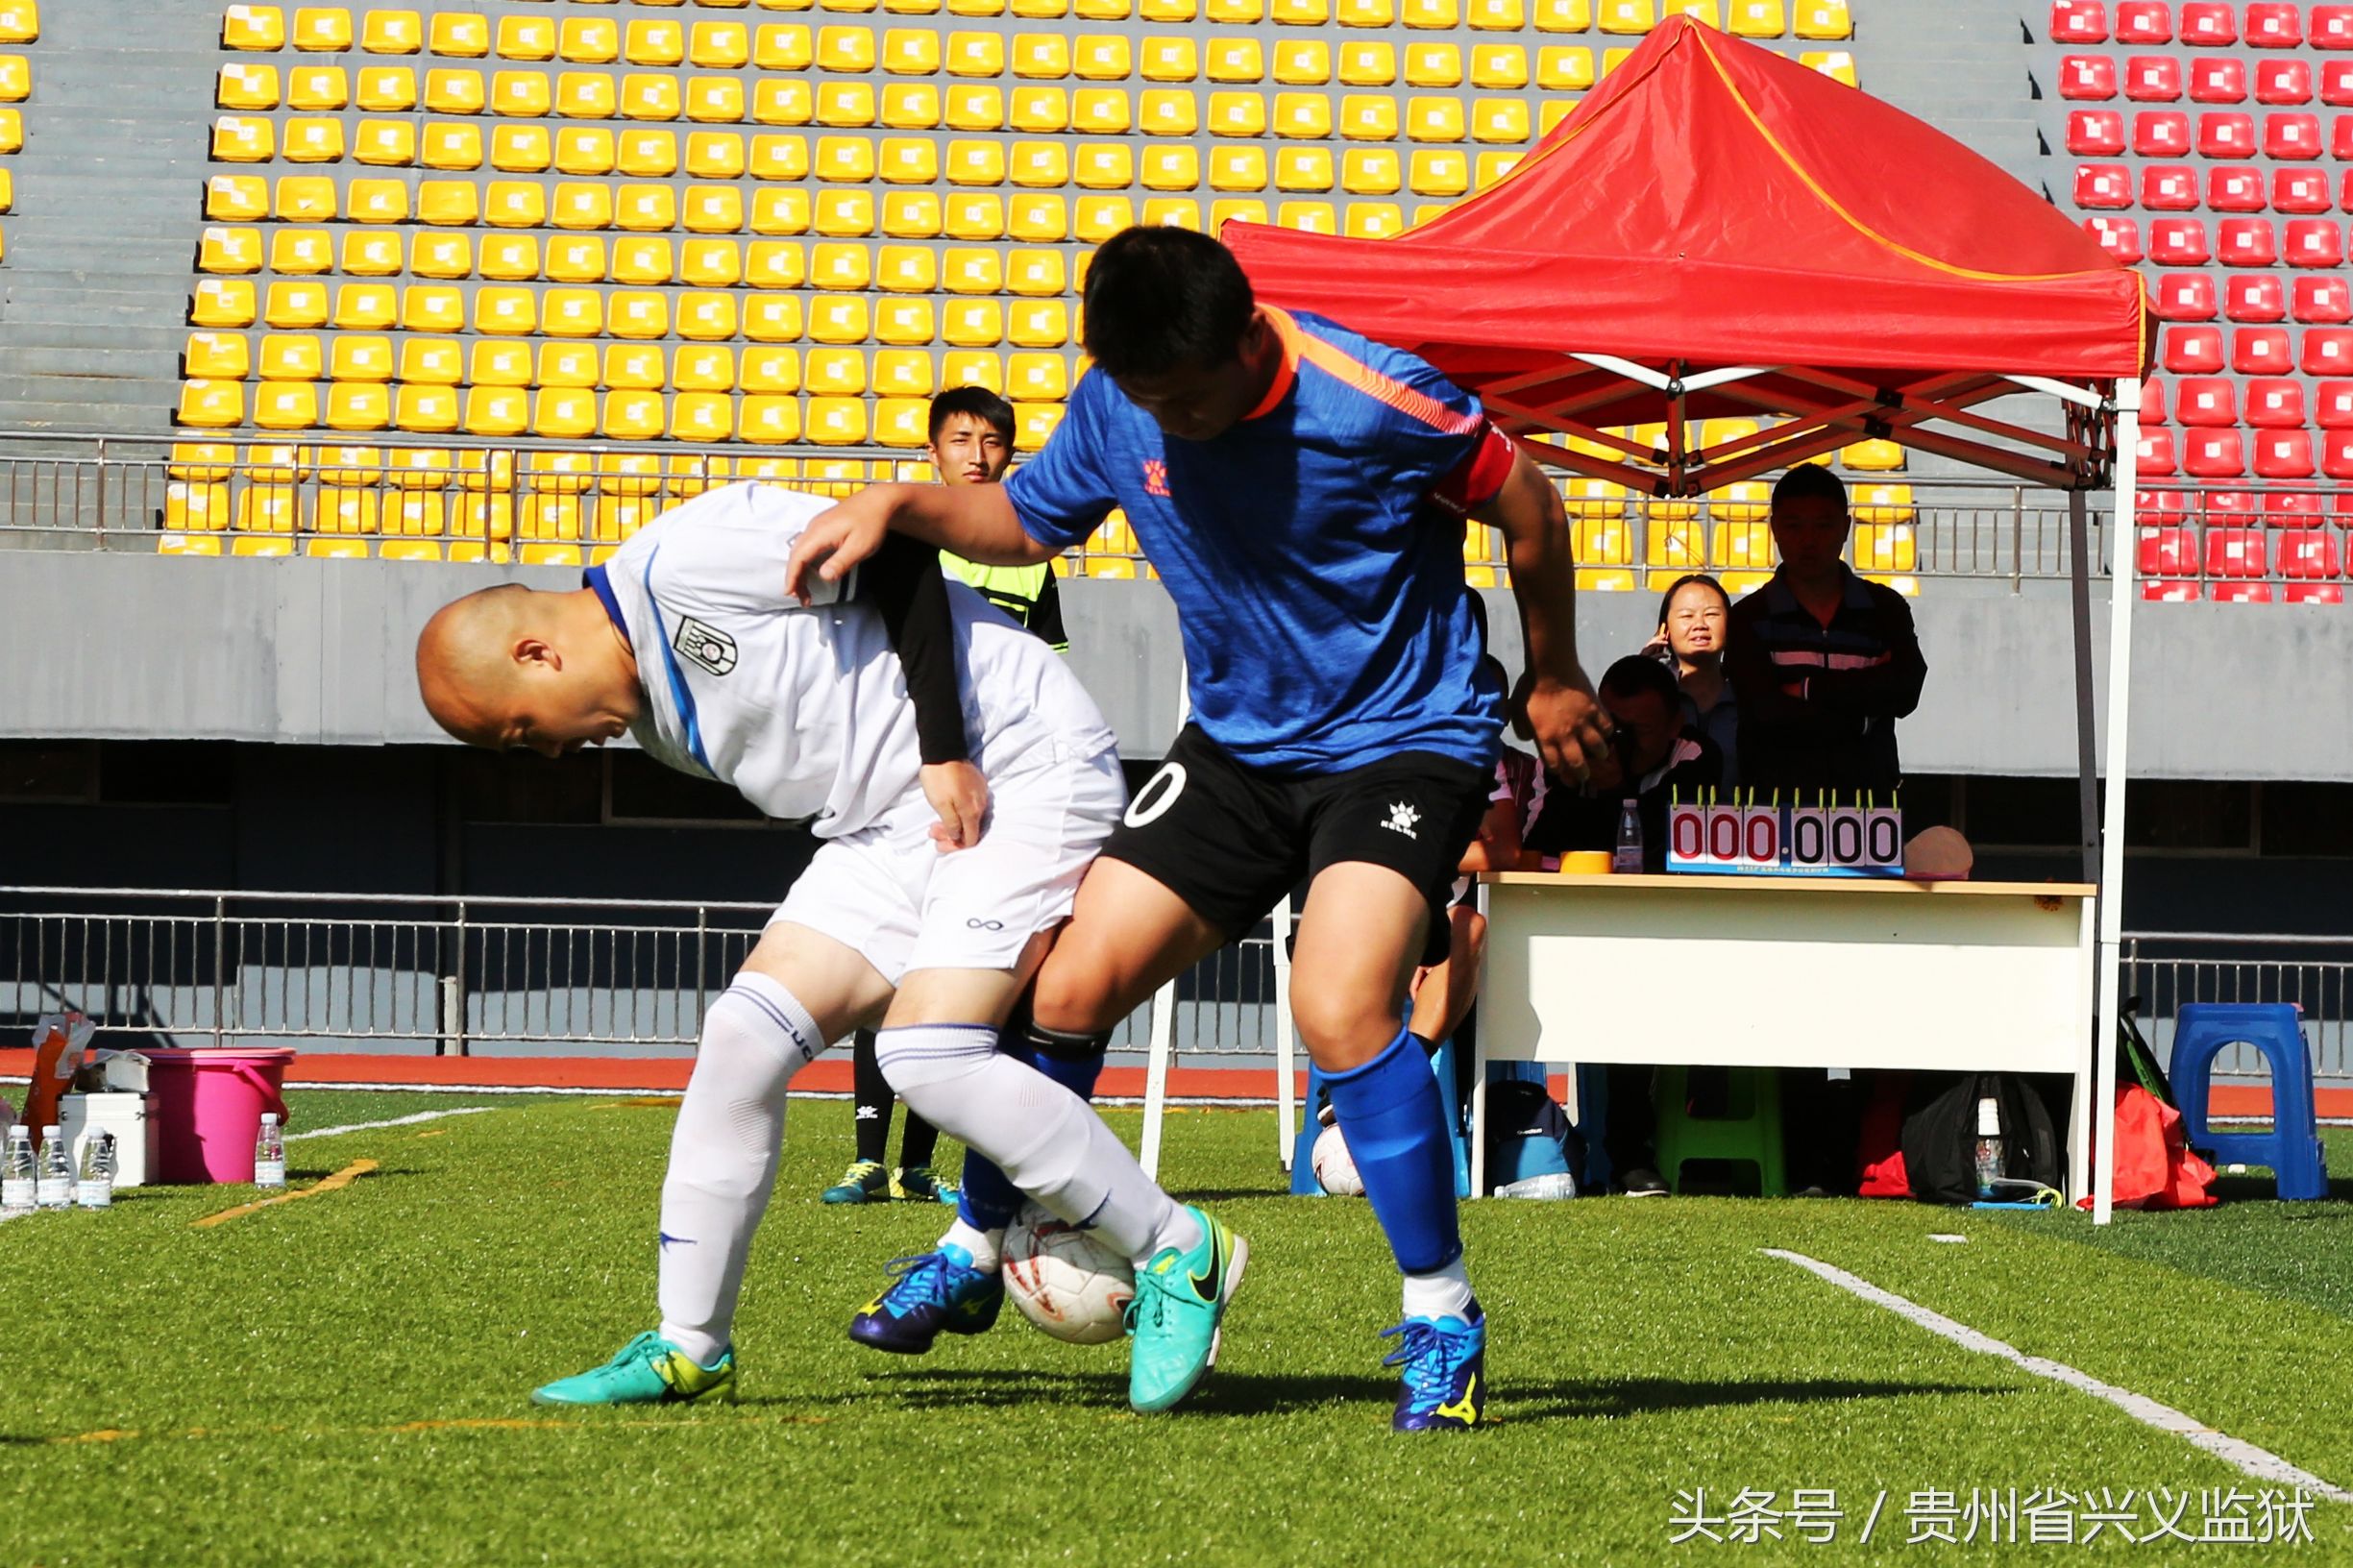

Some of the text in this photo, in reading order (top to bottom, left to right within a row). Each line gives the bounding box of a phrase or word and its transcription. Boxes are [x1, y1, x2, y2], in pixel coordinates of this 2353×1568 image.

[1123, 762, 1187, 828] 0
[1673, 813, 1899, 864] 000 000
